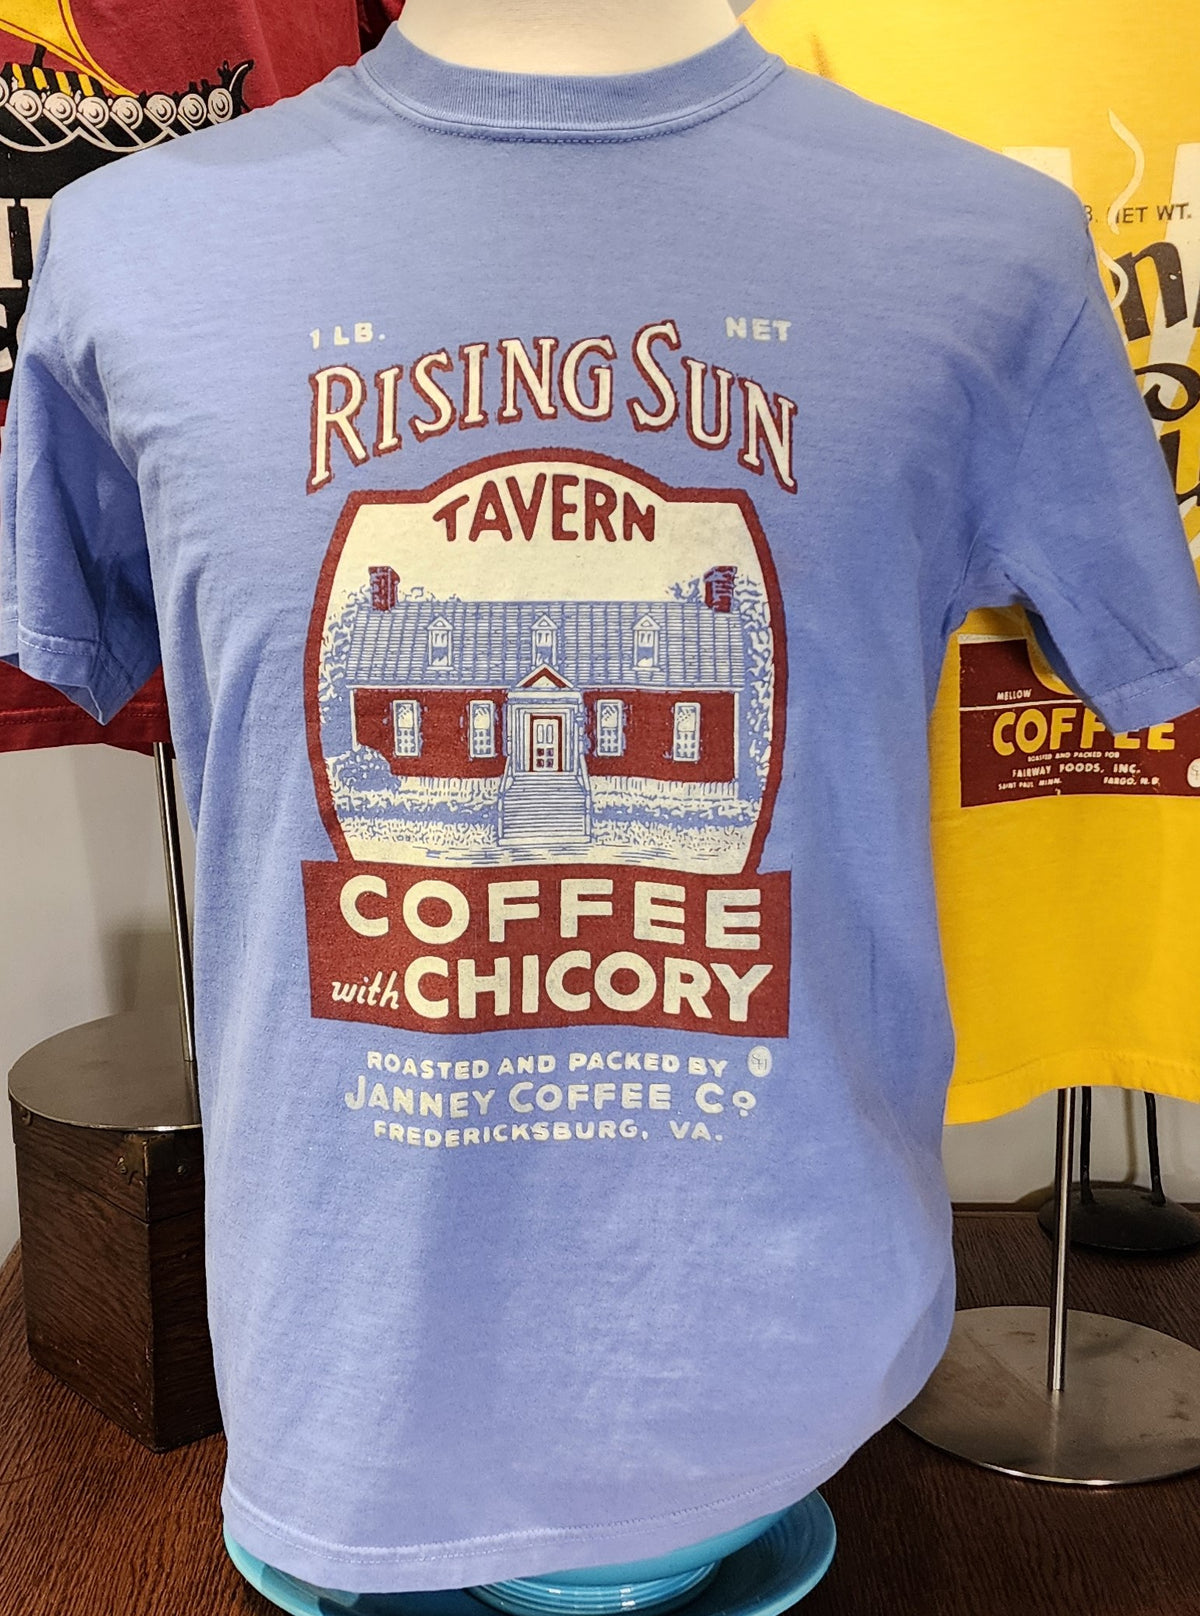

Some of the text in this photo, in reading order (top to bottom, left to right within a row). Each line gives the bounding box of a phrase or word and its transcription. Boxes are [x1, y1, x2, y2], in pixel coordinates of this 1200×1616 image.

[1156, 202, 1192, 220] WT.
[310, 321, 386, 349] 1 LB.
[725, 316, 792, 341] NET
[432, 472, 656, 543] TAVERN
[996, 688, 1032, 701] MELLOW
[1055, 752, 1071, 760] AND
[1073, 751, 1102, 759] PACKED
[1012, 762, 1141, 778] FAIRWAY FOODS, INC.
[998, 782, 1017, 791] SAINT
[339, 874, 761, 950] COFFEE
[331, 950, 774, 1022] with CHICORY
[367, 1051, 490, 1080] ROASTED
[498, 1055, 556, 1075] AND
[569, 1051, 680, 1073] PACKED
[688, 1056, 728, 1077] BY
[374, 1120, 723, 1147] FREDERICKSBURG, VA.
